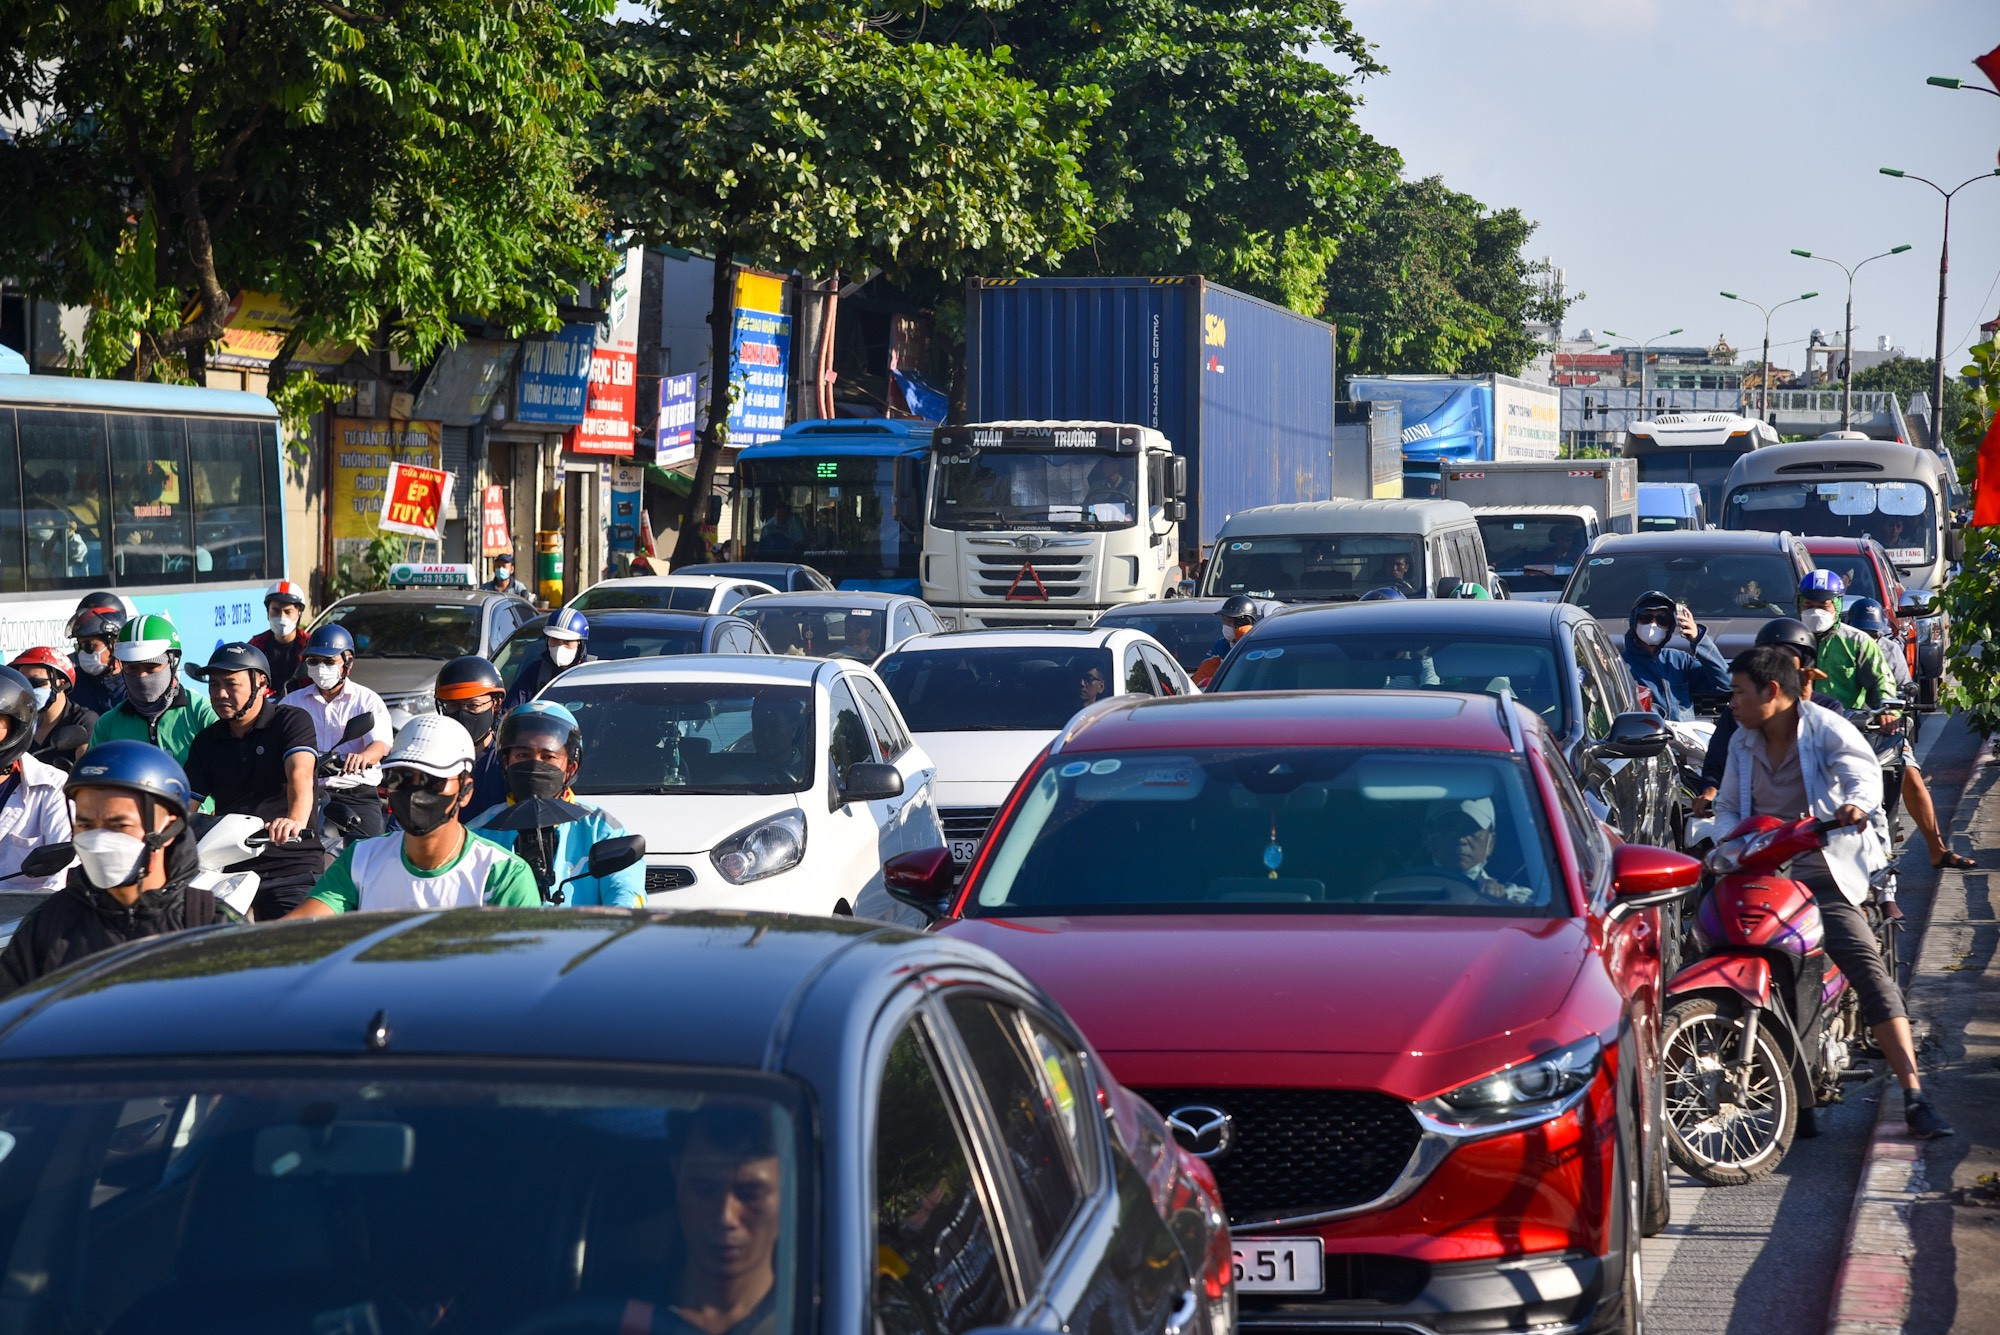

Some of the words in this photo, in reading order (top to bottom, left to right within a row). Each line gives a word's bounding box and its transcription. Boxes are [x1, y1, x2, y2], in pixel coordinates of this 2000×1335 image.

[591, 357, 611, 390] GỌC
[551, 382, 566, 406] CÁC
[566, 387, 582, 411] LOẠI
[973, 428, 1003, 447] XUÂN
[1054, 428, 1097, 448] TRƯỜNG
[1012, 428, 1053, 437] FAW
[1402, 423, 1432, 444] MINH
[340, 451, 371, 467] THÔNG
[374, 453, 389, 467] TIN
[355, 476, 375, 490] CHO
[407, 480, 429, 502] ÉP
[392, 503, 421, 524] TUY
[445, 565, 456, 573] 25
[214, 605, 226, 627] 29B
[0, 617, 18, 651] ÂM
